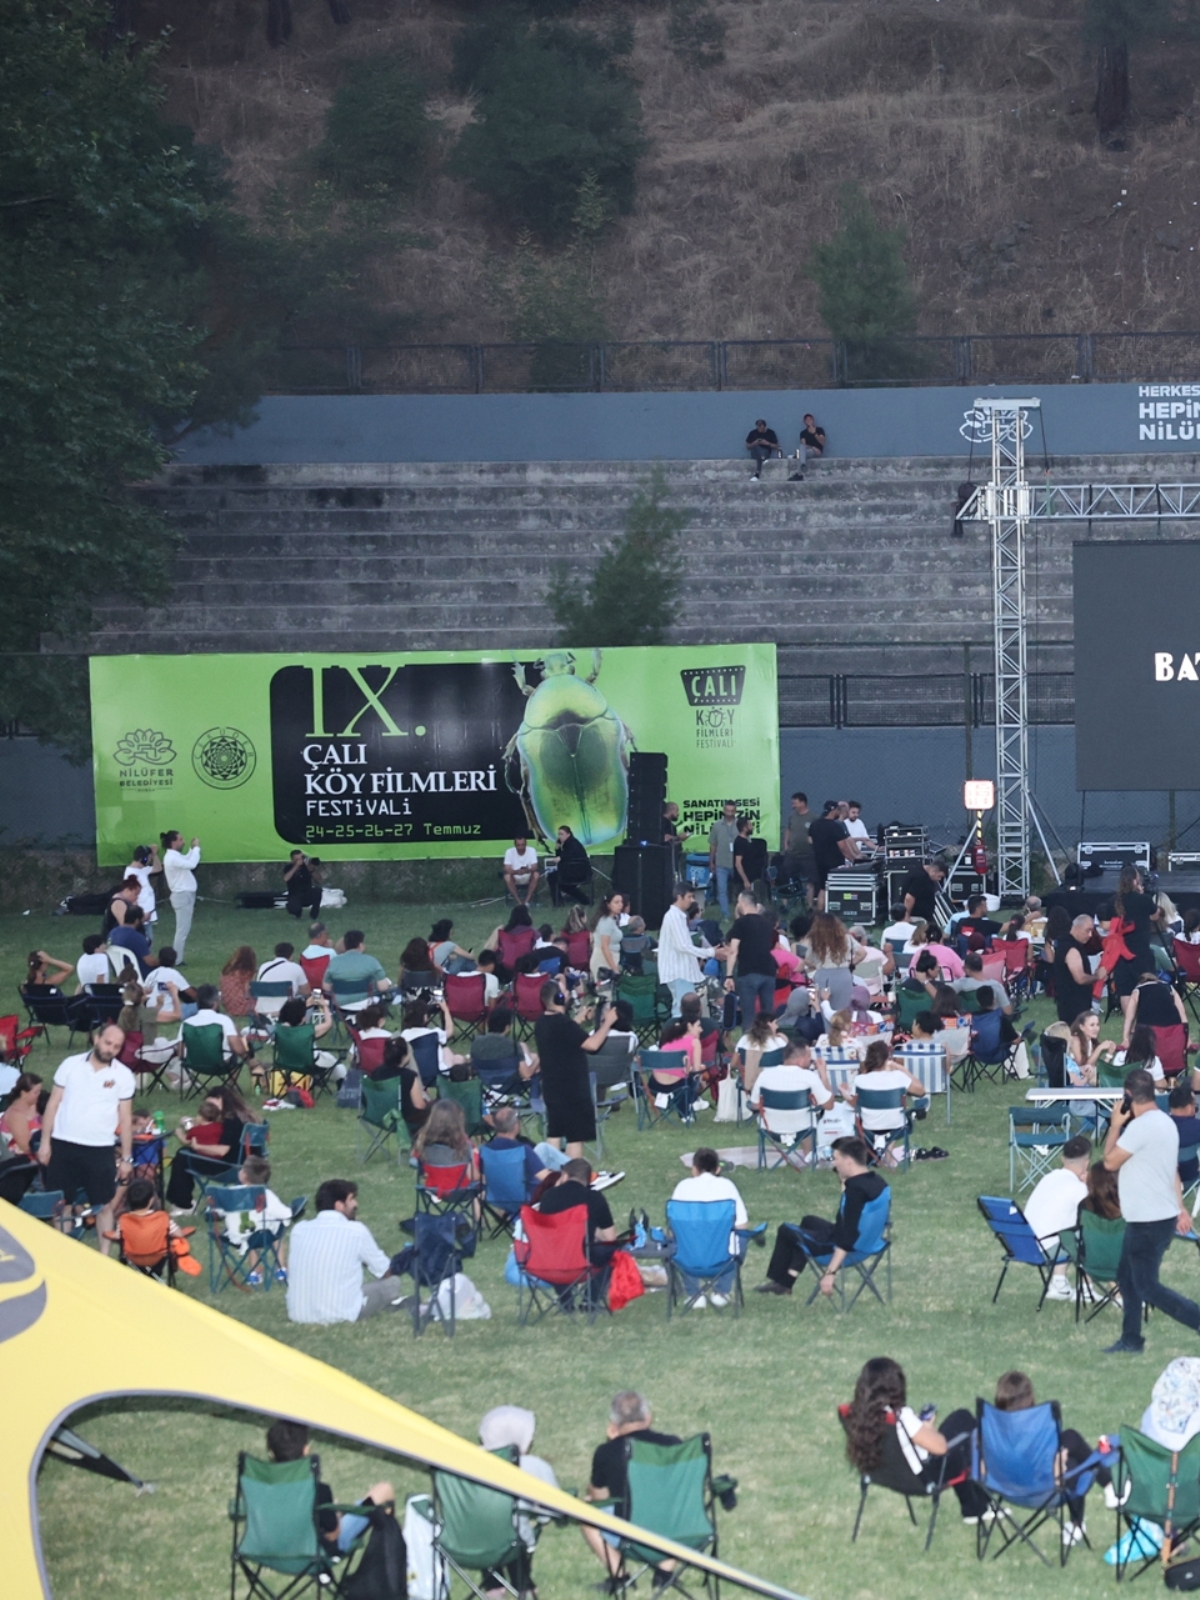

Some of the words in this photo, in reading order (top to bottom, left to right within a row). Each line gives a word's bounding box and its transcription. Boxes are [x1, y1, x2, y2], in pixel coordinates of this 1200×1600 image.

[303, 664, 427, 737] IX.
[691, 675, 736, 703] ÇALI
[303, 744, 368, 770] ÇALI
[304, 767, 365, 795] KÖY
[370, 764, 497, 793] FİLMLERİ
[306, 824, 413, 838] 24-25-26-27
[424, 823, 482, 836] Temmuz
